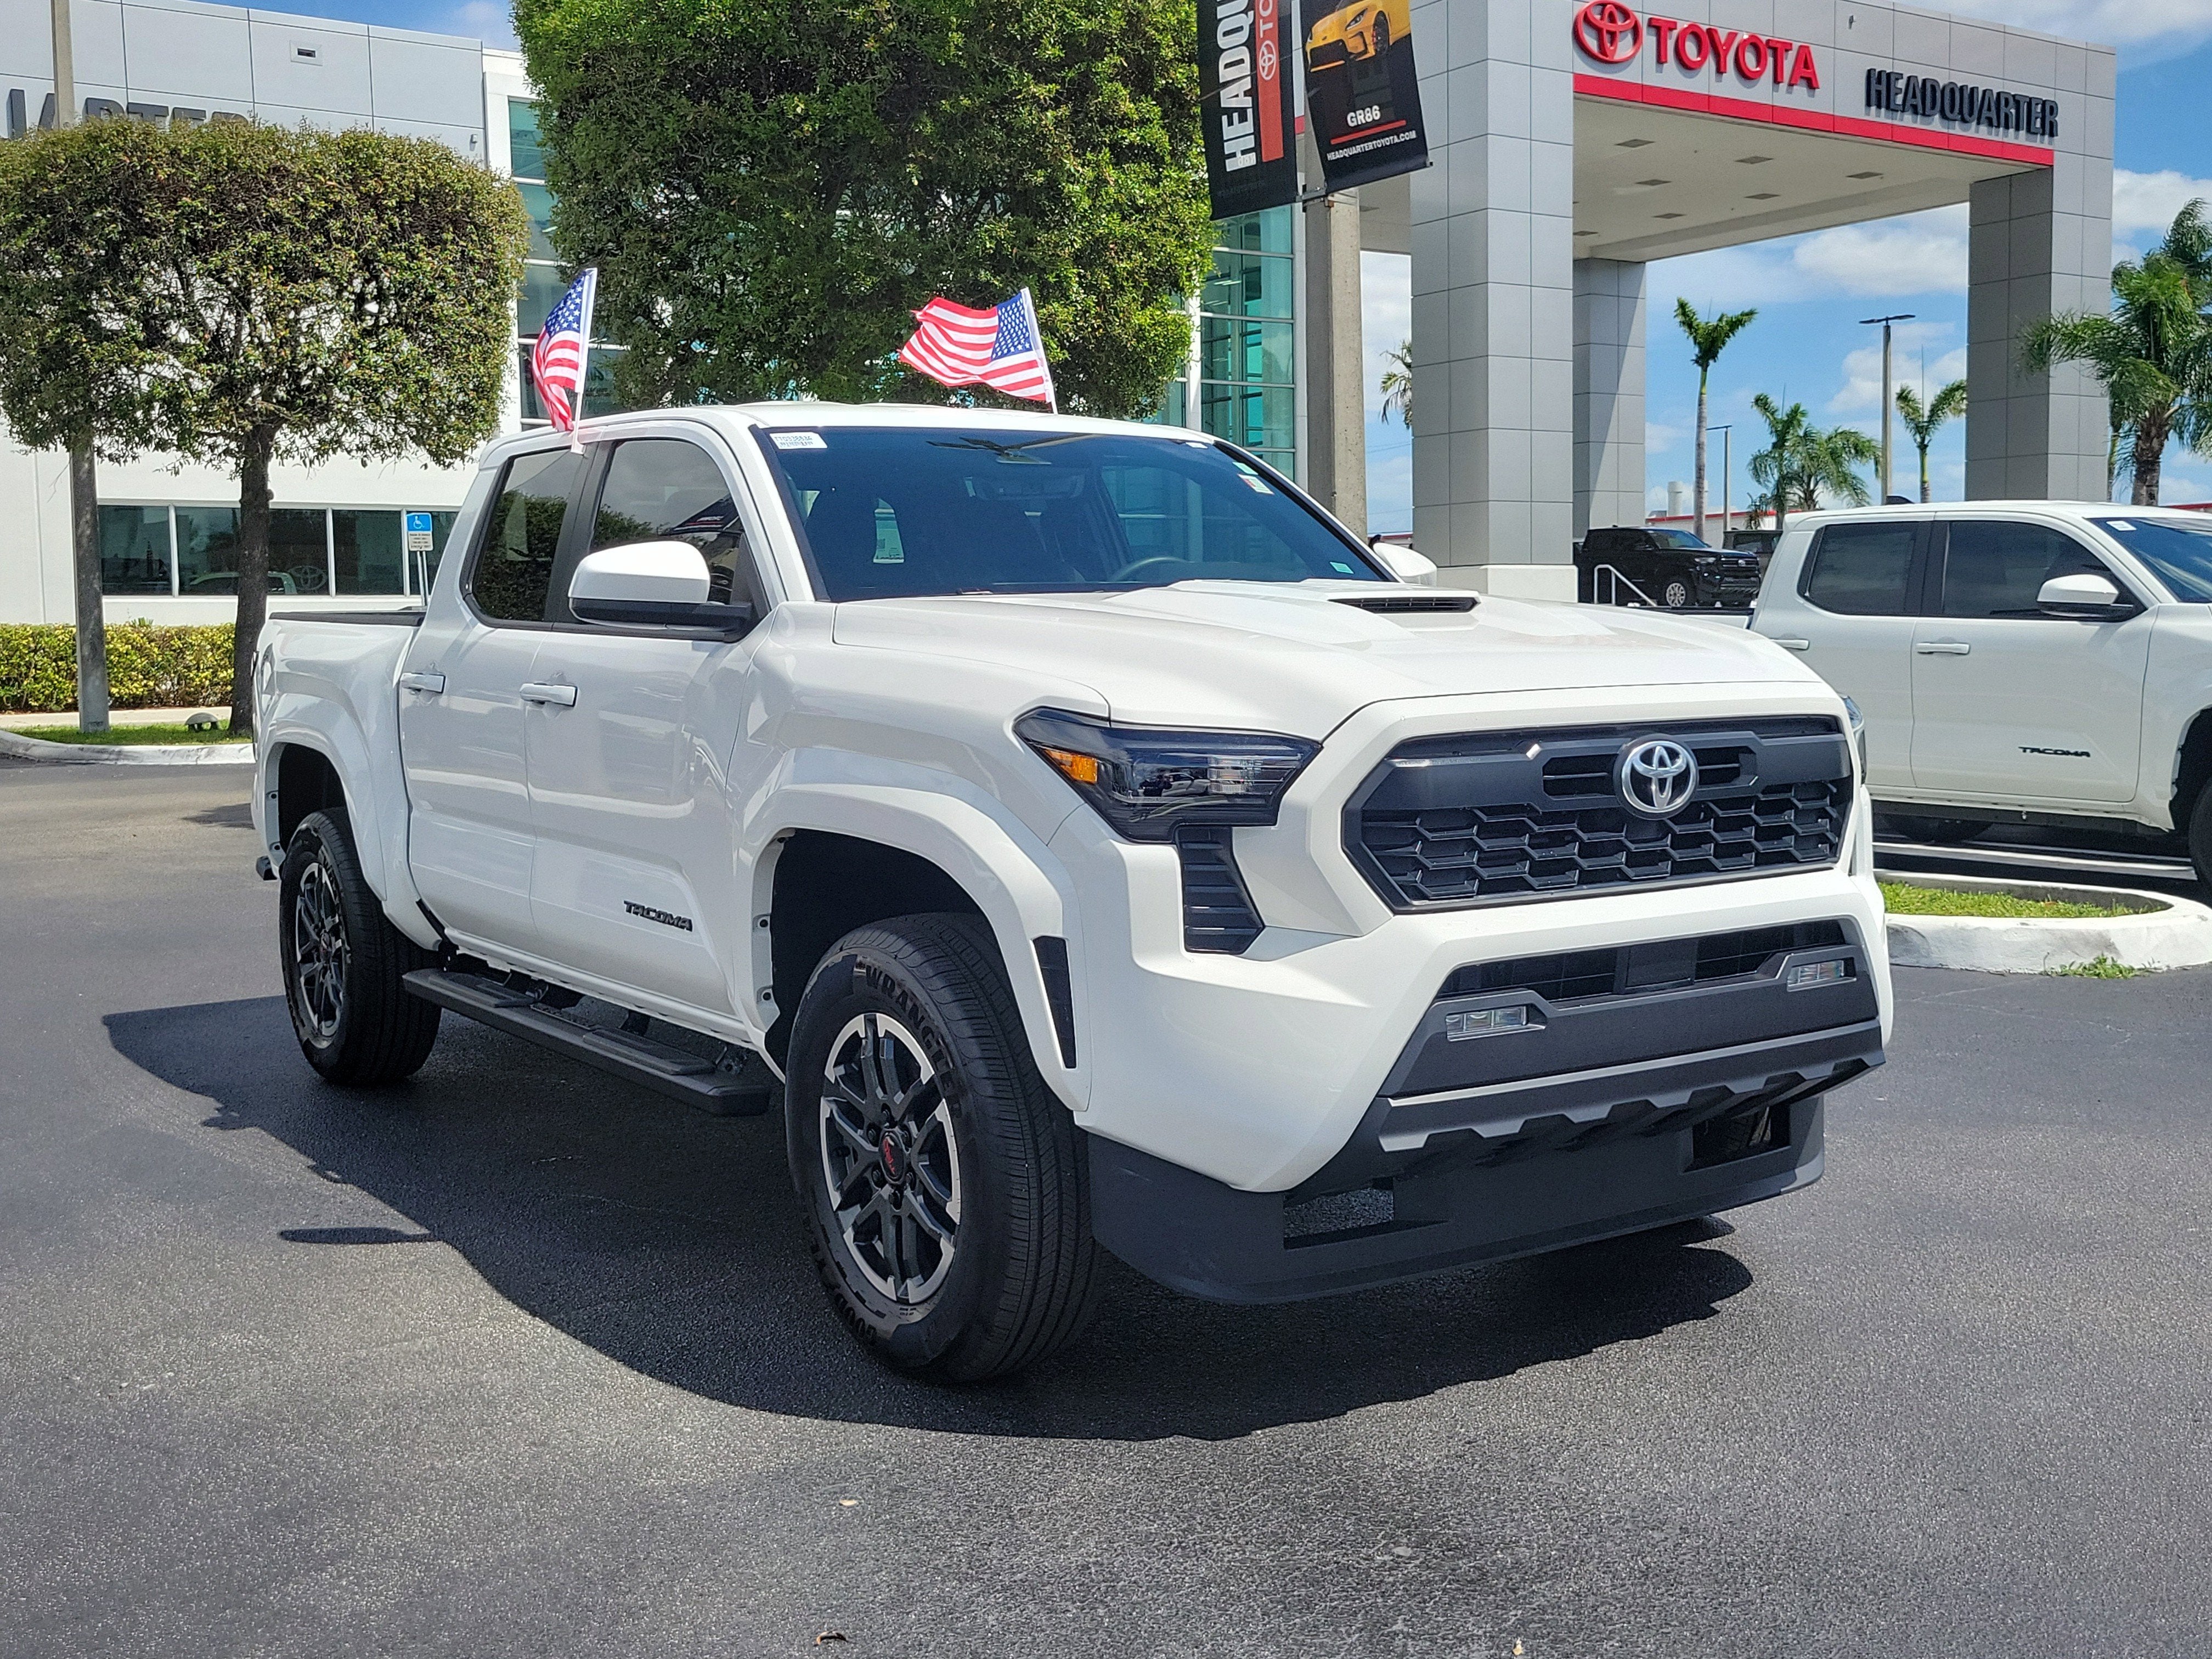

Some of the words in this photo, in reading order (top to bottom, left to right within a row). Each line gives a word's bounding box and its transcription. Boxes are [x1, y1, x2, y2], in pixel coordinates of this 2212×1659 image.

[1647, 17, 1820, 89] TOYOTA
[1347, 105, 1381, 127] GR86
[1865, 68, 2058, 138] HEADQUARTER
[1327, 130, 1417, 161] HEADQUARTERTOYOTA.COM
[2018, 746, 2091, 758] TACOMA
[624, 900, 693, 932] TACOMA
[865, 964, 963, 1118] WRANGLER
